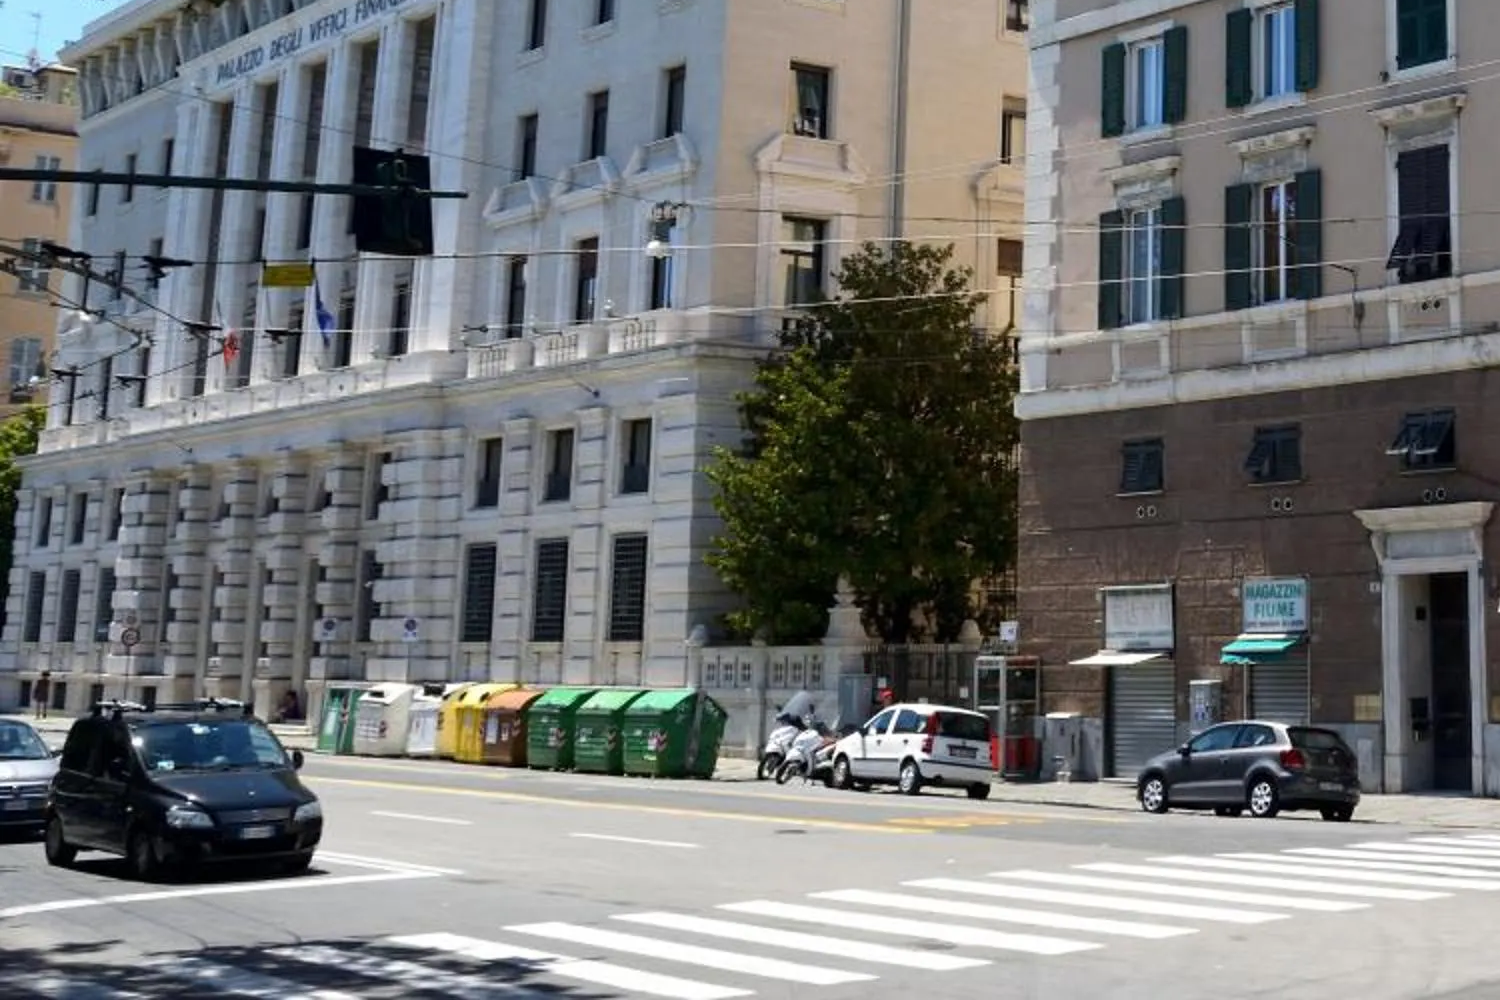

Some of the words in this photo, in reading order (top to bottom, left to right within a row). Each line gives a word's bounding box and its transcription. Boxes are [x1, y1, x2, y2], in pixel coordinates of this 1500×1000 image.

[217, 46, 263, 84] PALAZZO
[269, 28, 304, 61] DEGLI
[1254, 601, 1296, 618] FIUME
